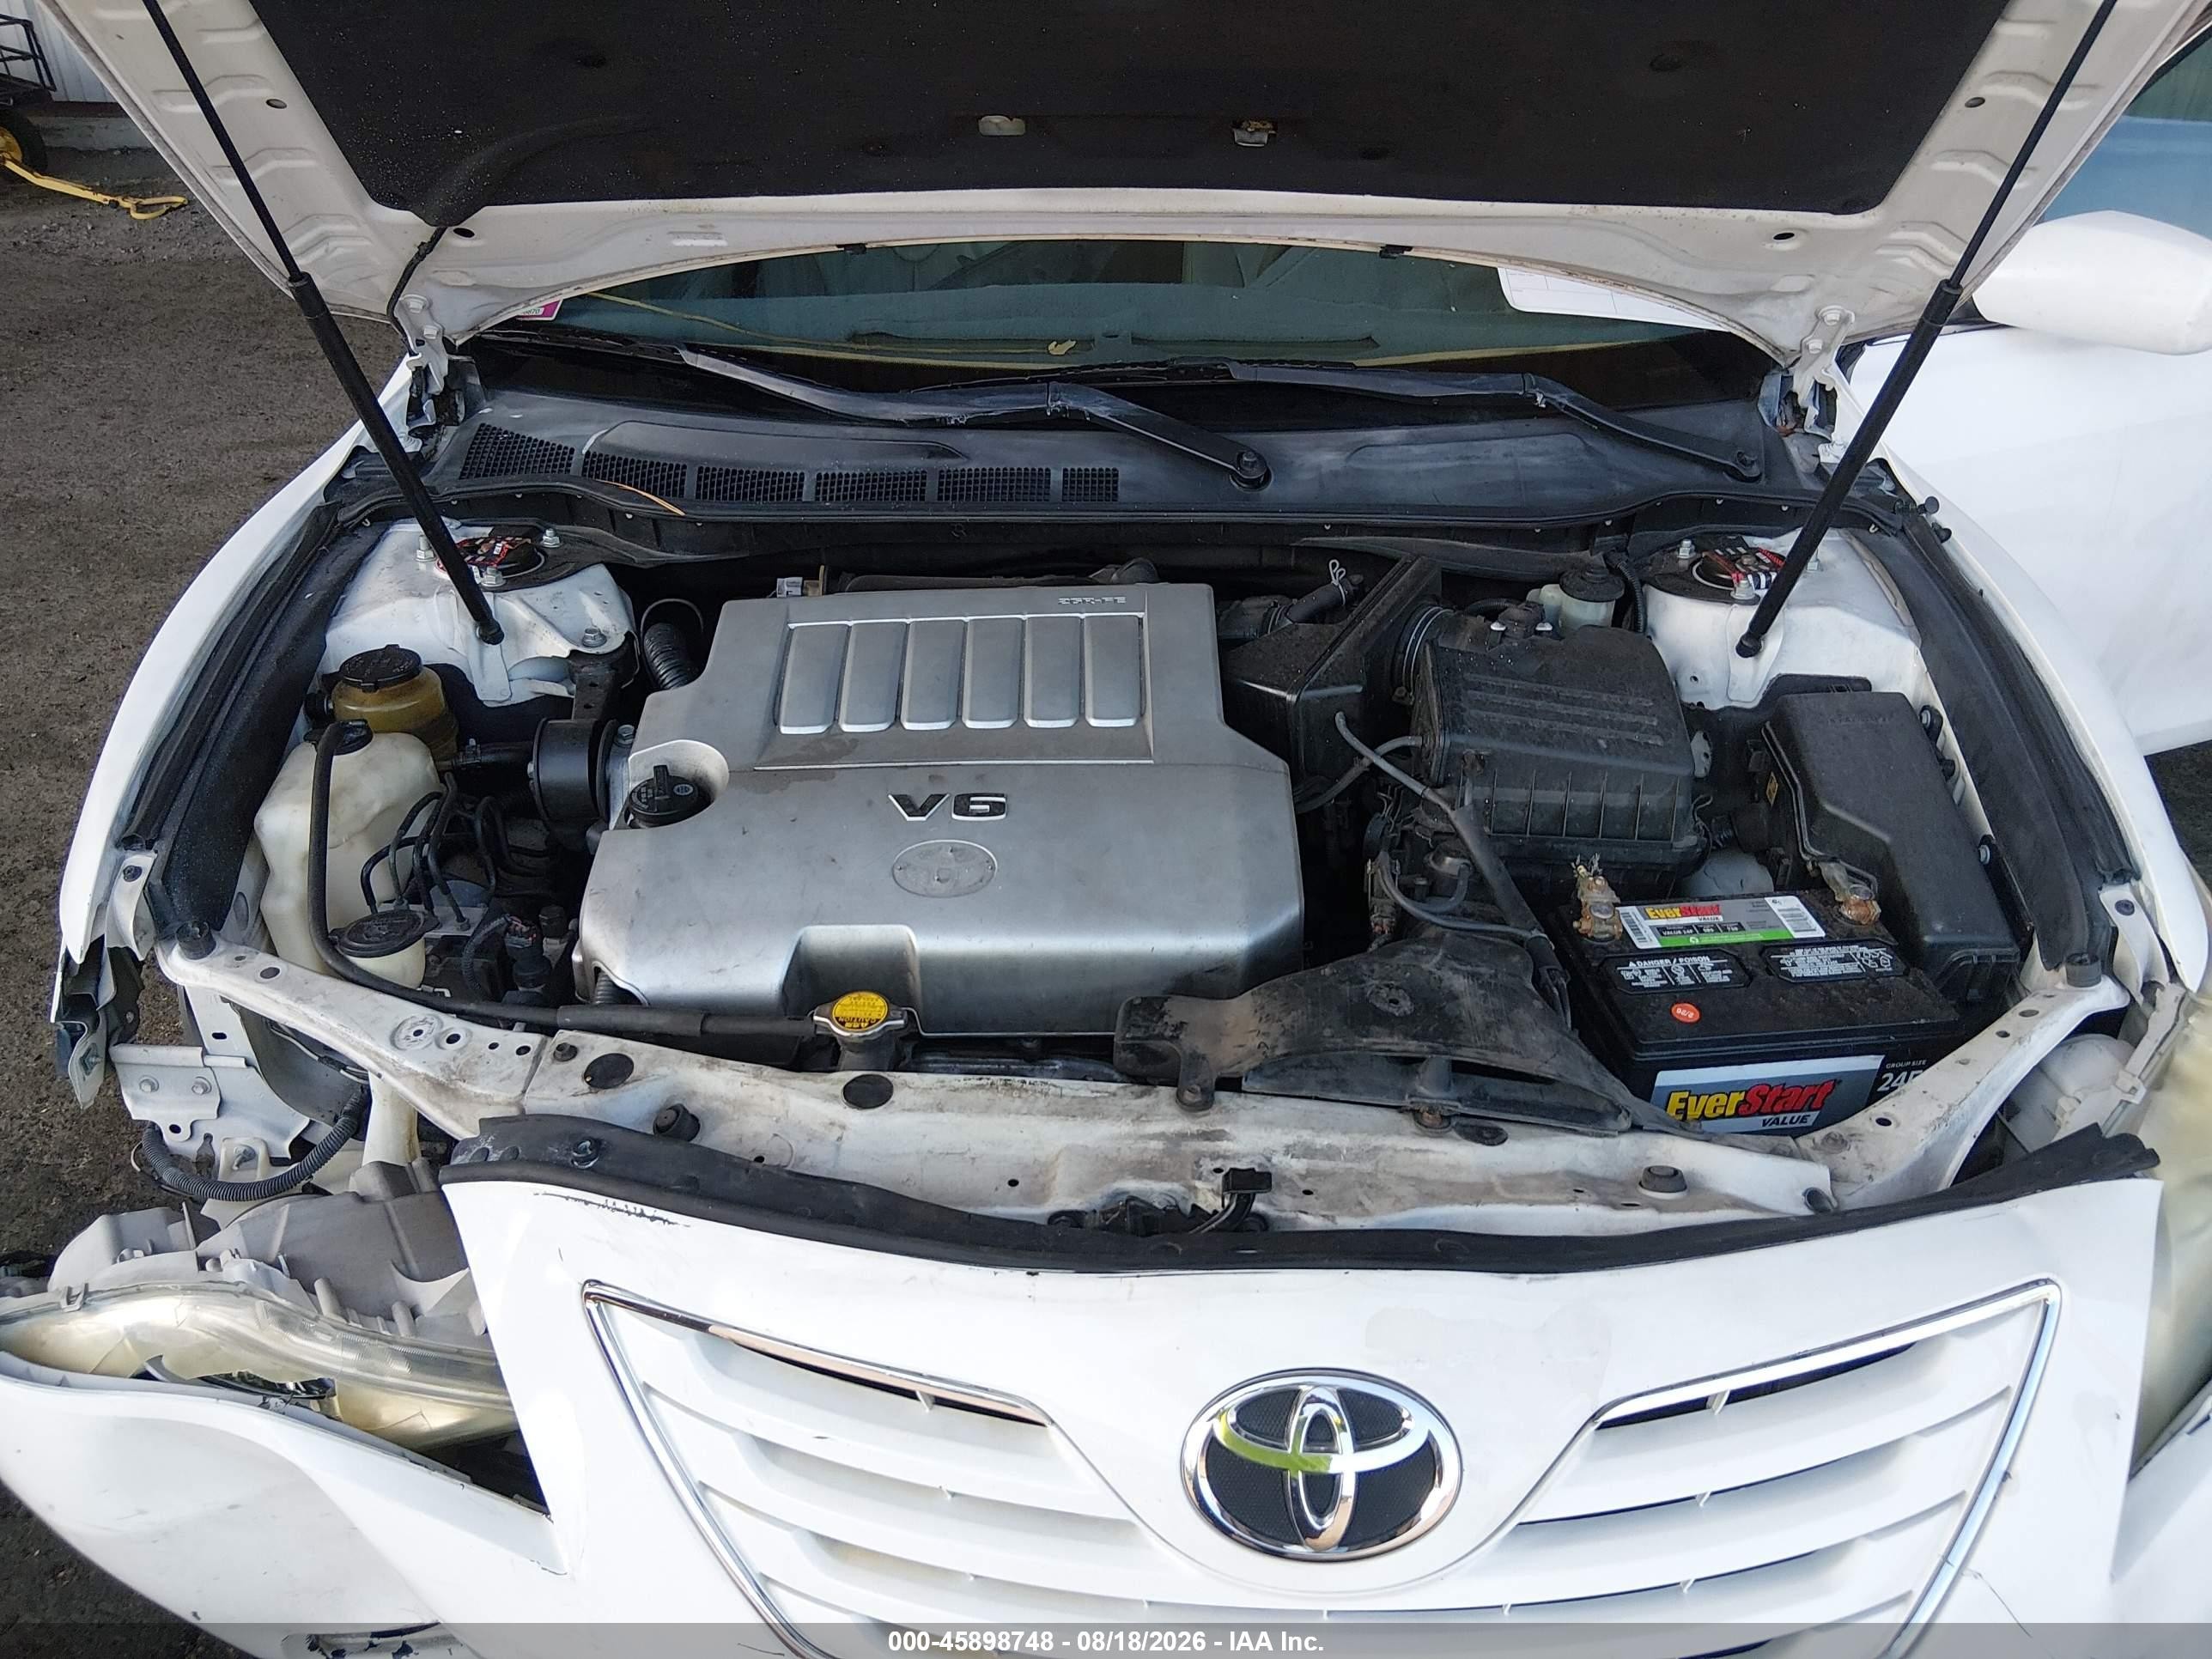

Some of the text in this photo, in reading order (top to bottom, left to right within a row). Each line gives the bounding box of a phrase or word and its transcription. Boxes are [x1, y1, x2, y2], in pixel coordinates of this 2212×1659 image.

[888, 792, 1006, 822] V6
[1637, 959, 1672, 968] DANGER
[1886, 1060, 1911, 1069] GROUP
[1666, 1079, 1835, 1121] EverStart
[1760, 1114, 1809, 1127] VALUE
